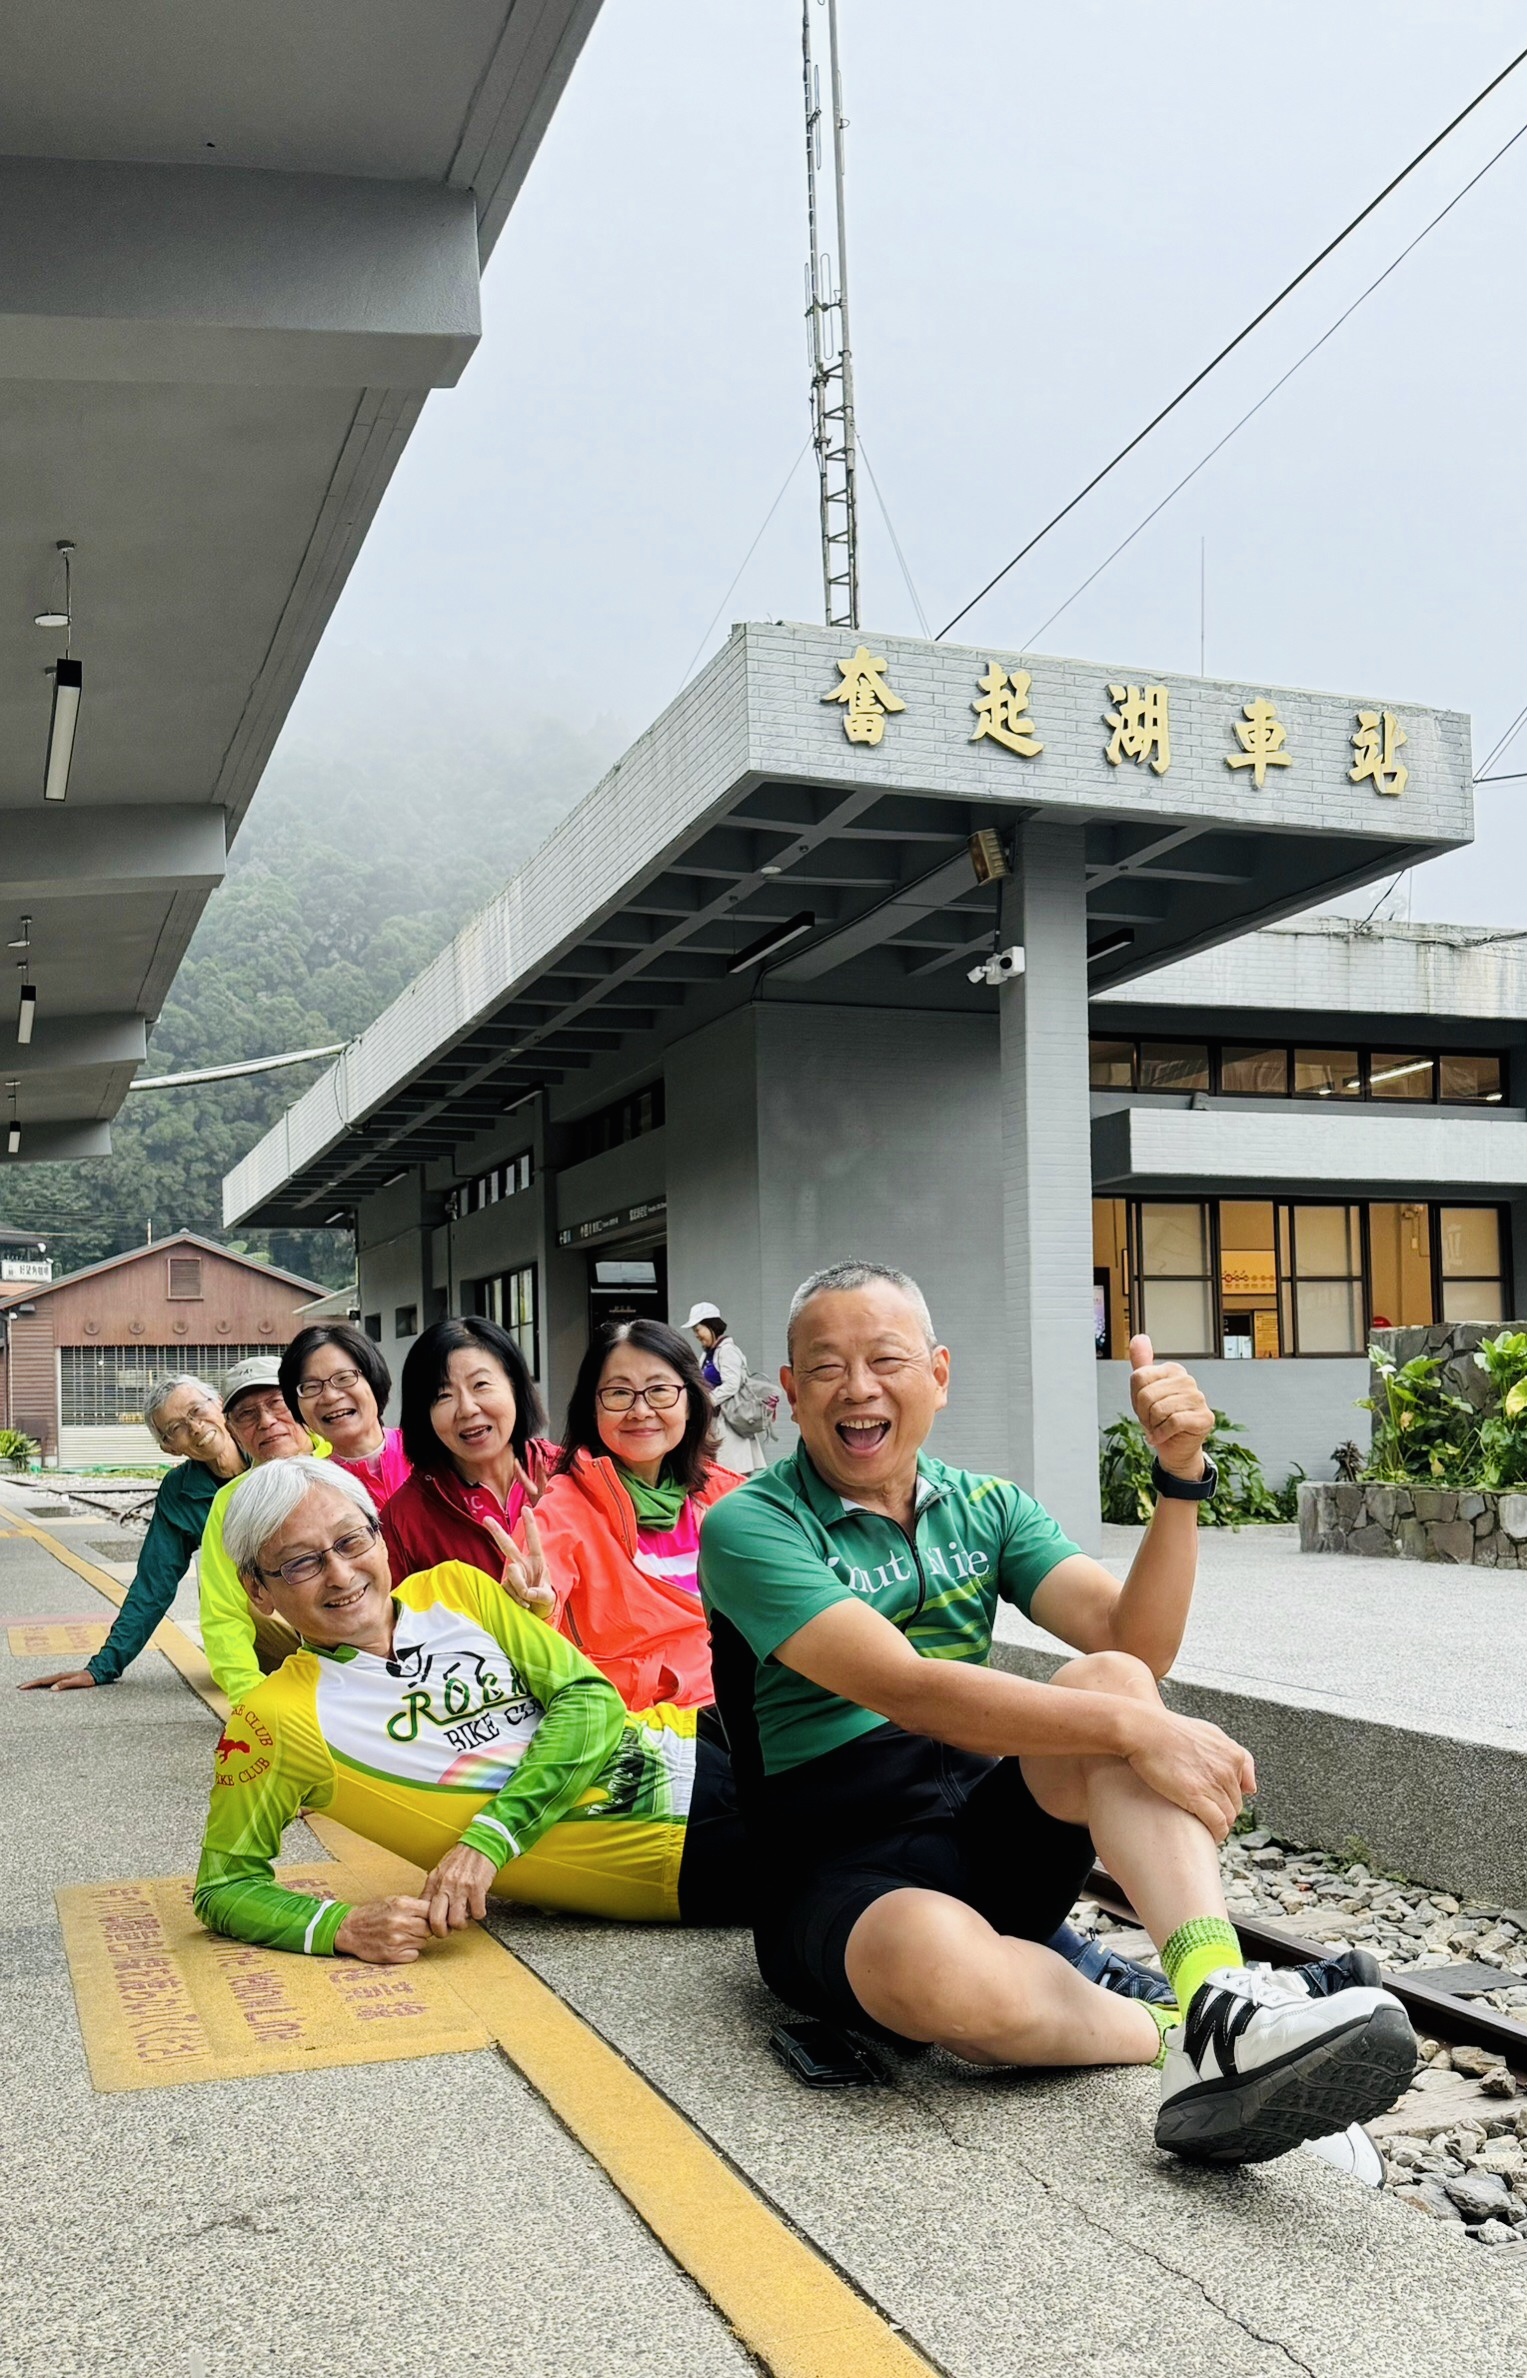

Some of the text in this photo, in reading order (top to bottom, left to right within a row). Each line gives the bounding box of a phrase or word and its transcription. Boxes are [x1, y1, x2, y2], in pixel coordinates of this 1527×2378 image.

[823, 645, 1408, 797] 奮起湖車站
[245, 1711, 273, 1746] CLUB
[443, 1712, 500, 1752] BIKE
[239, 1757, 270, 1783] CLUB
[226, 1969, 290, 2008] Yellow
[243, 2006, 307, 2041] Line
